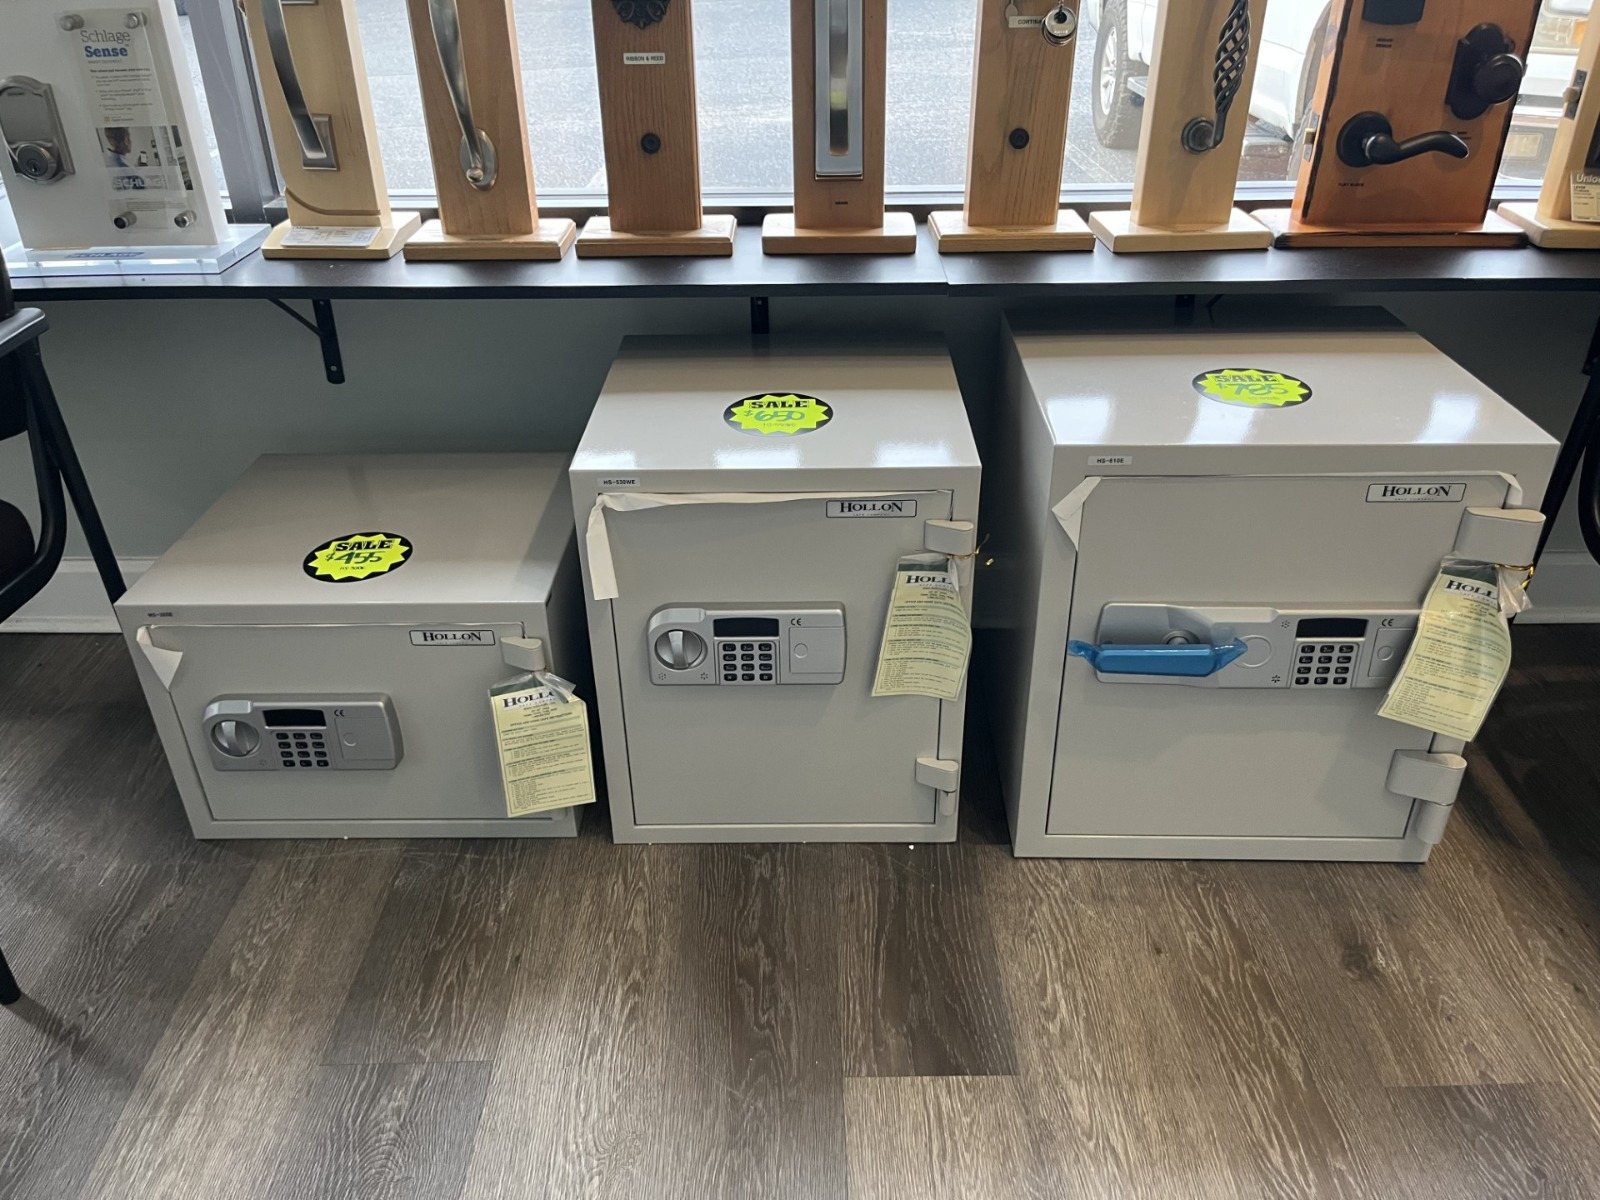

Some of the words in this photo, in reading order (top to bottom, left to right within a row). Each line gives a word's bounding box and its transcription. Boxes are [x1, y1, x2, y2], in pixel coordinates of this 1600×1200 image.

[80, 29, 130, 45] Schlage
[84, 45, 128, 58] Sense
[1576, 173, 1600, 184] Unio
[1213, 374, 1280, 383] SALE
[749, 400, 809, 409] SALE
[743, 410, 806, 422] $650
[1382, 485, 1452, 497] HOLLON
[840, 502, 903, 512] HOLLON
[335, 539, 394, 552] SALE
[324, 550, 386, 565] $455
[905, 574, 953, 584] HOLL
[1445, 579, 1498, 598] HOLL
[423, 631, 482, 641] HOLLON
[502, 690, 555, 708] HOLL
